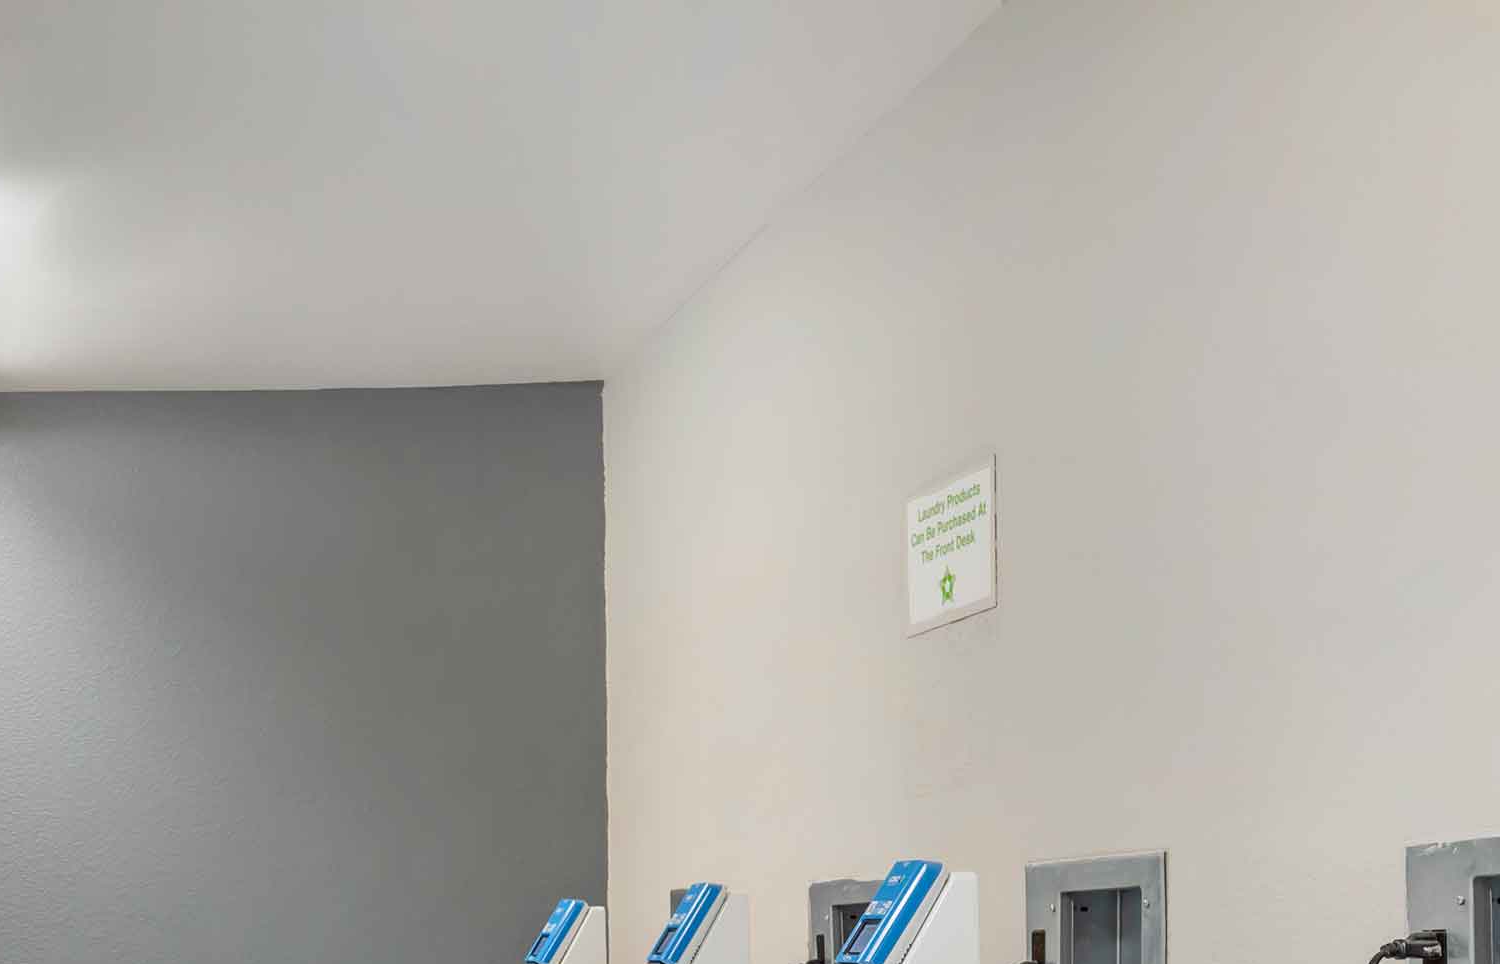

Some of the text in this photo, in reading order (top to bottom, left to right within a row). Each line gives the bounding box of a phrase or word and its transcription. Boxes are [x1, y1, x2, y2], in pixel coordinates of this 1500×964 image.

[916, 483, 981, 523] Laundry Products
[911, 500, 987, 548] Can Be Purchased At
[922, 529, 975, 564] The Front Desk
